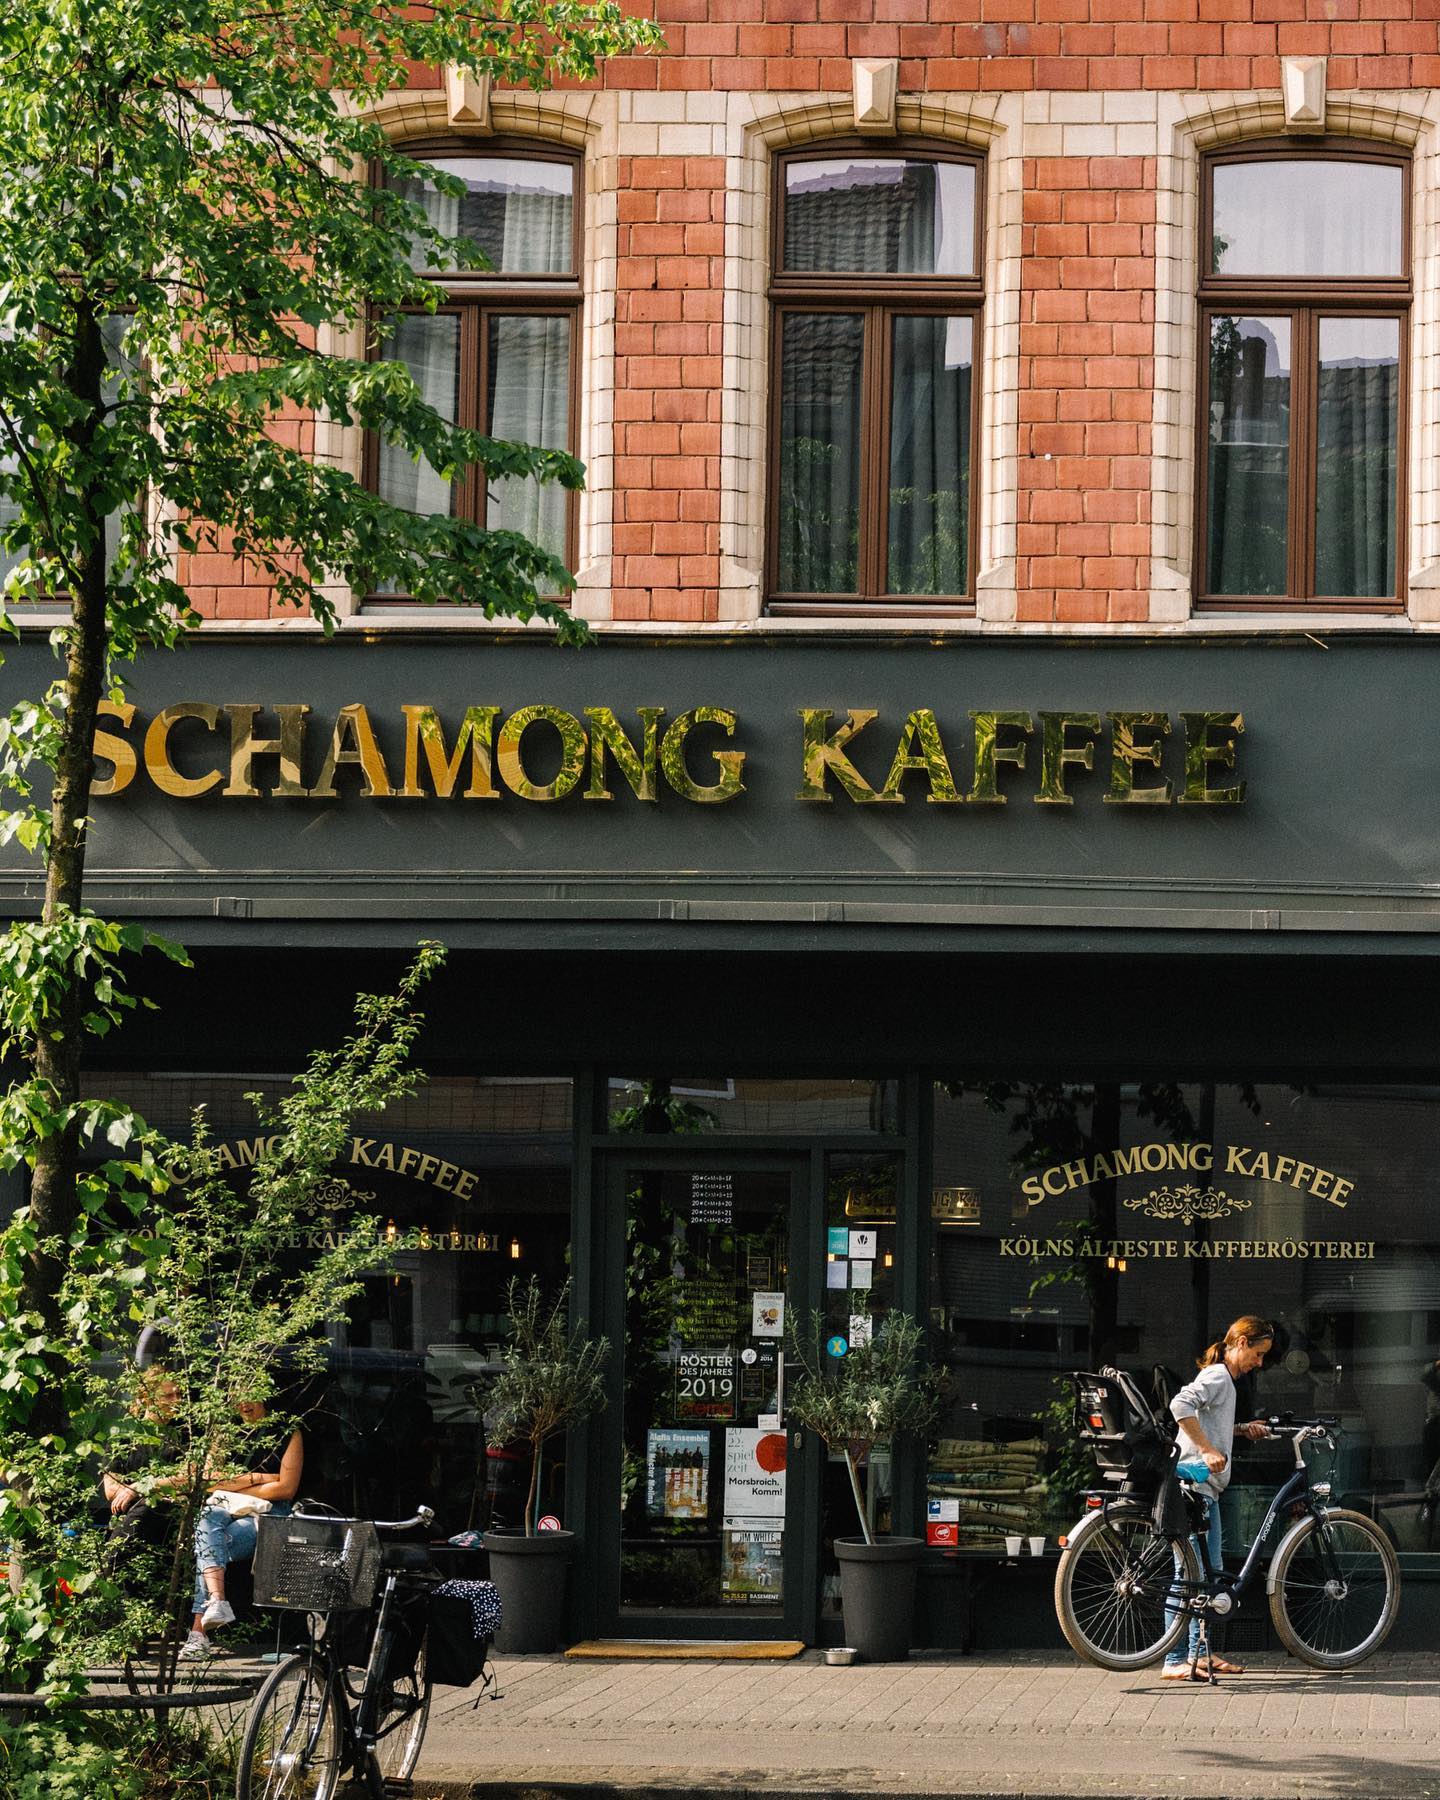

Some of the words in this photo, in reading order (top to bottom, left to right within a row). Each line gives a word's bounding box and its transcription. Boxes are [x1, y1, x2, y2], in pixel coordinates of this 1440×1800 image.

[89, 698, 747, 801] SCHAMONG
[794, 707, 1248, 805] KAFFEE
[349, 1136, 480, 1201] KAFFEE
[1021, 1142, 1214, 1206] SCHAMONG
[1224, 1144, 1355, 1209] KAFFEE
[999, 1234, 1074, 1257] KÖLNS
[1079, 1234, 1178, 1258] ÄLTESTE
[1182, 1236, 1375, 1259] KAFFEERÖSTEREI
[680, 1354, 733, 1367] RÖSTER
[700, 1368, 733, 1377] JAHRES
[679, 1378, 733, 1397] 2019
[672, 1433, 709, 1442] Ensemble
[728, 1477, 780, 1486] Morsbroich.
[751, 1487, 783, 1496] Komm!
[753, 1532, 774, 1542] WHITE
